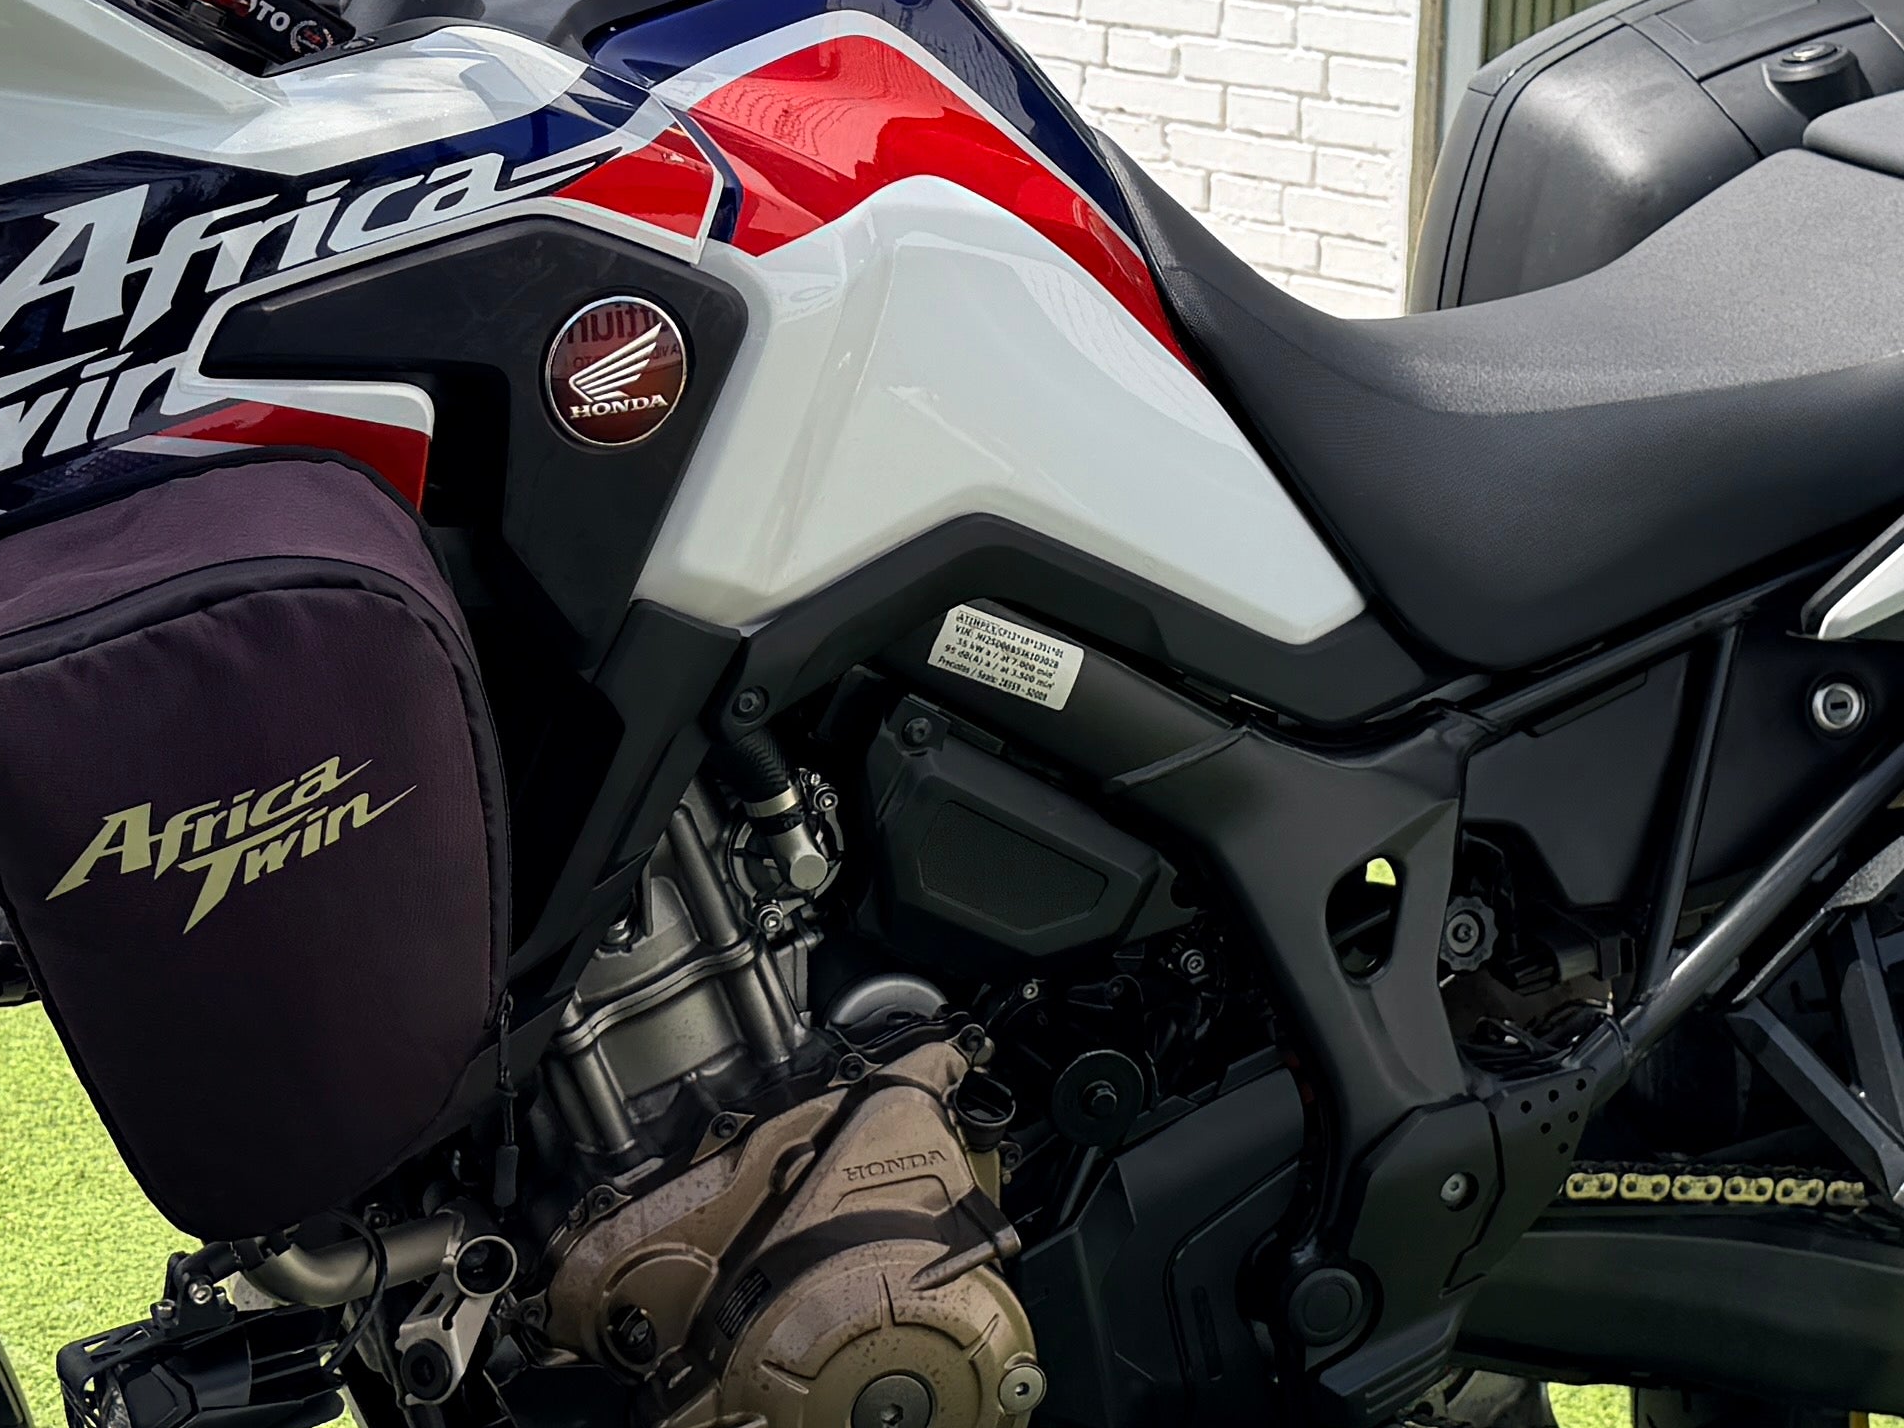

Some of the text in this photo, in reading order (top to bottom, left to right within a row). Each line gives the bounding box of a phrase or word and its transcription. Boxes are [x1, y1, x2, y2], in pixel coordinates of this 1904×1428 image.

[569, 394, 669, 420] HONDA
[46, 756, 374, 901] Africa
[178, 784, 418, 934] Twin
[842, 1150, 947, 1181] HONDA
